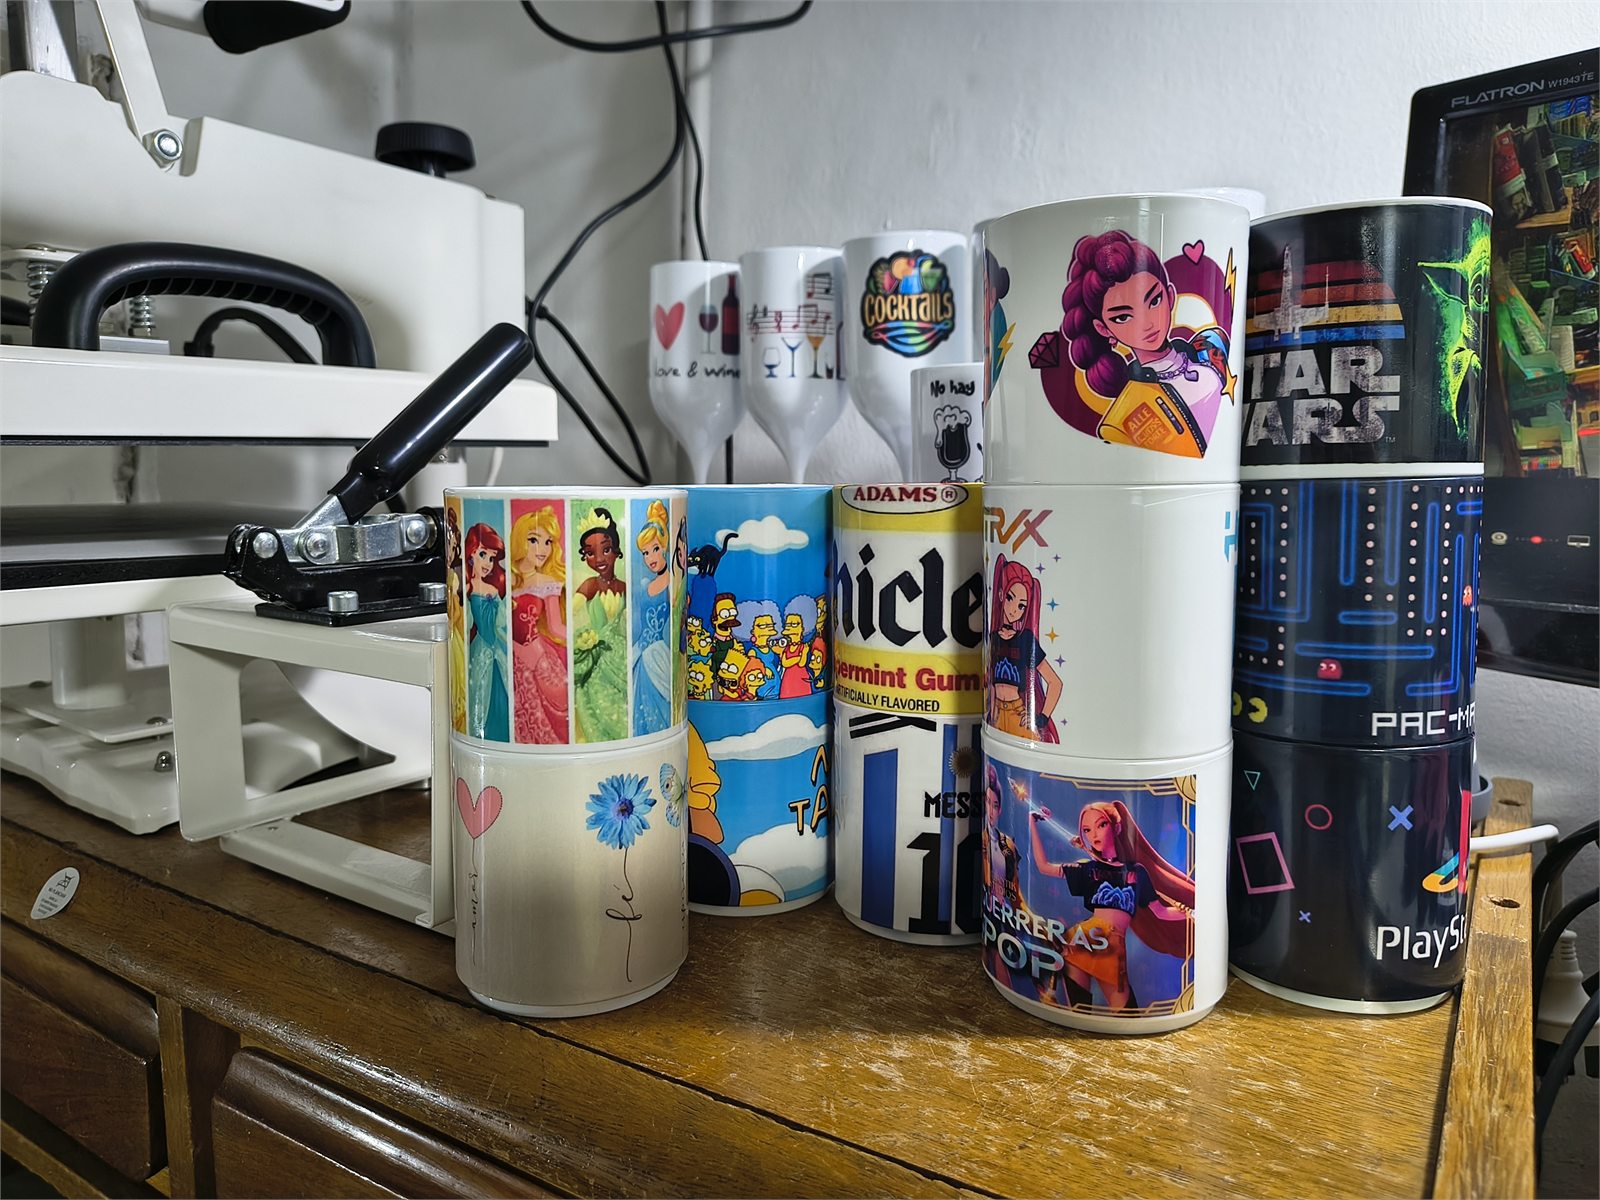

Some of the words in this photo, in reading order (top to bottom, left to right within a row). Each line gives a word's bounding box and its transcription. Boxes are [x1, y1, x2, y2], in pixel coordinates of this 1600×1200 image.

[1451, 79, 1545, 108] FLATRON
[1548, 71, 1595, 88] W1943TE
[865, 292, 953, 327] COCKTAILS
[655, 358, 681, 377] love
[687, 360, 698, 378] &
[930, 380, 946, 398] No
[950, 379, 976, 397] hay
[1243, 396, 1401, 447] ARS
[853, 486, 938, 503] ADAMS
[915, 668, 981, 692] Gum
[881, 695, 940, 712] FLAVORED
[983, 884, 1109, 952] UERRERAS
[1376, 914, 1467, 969] PlaySt
